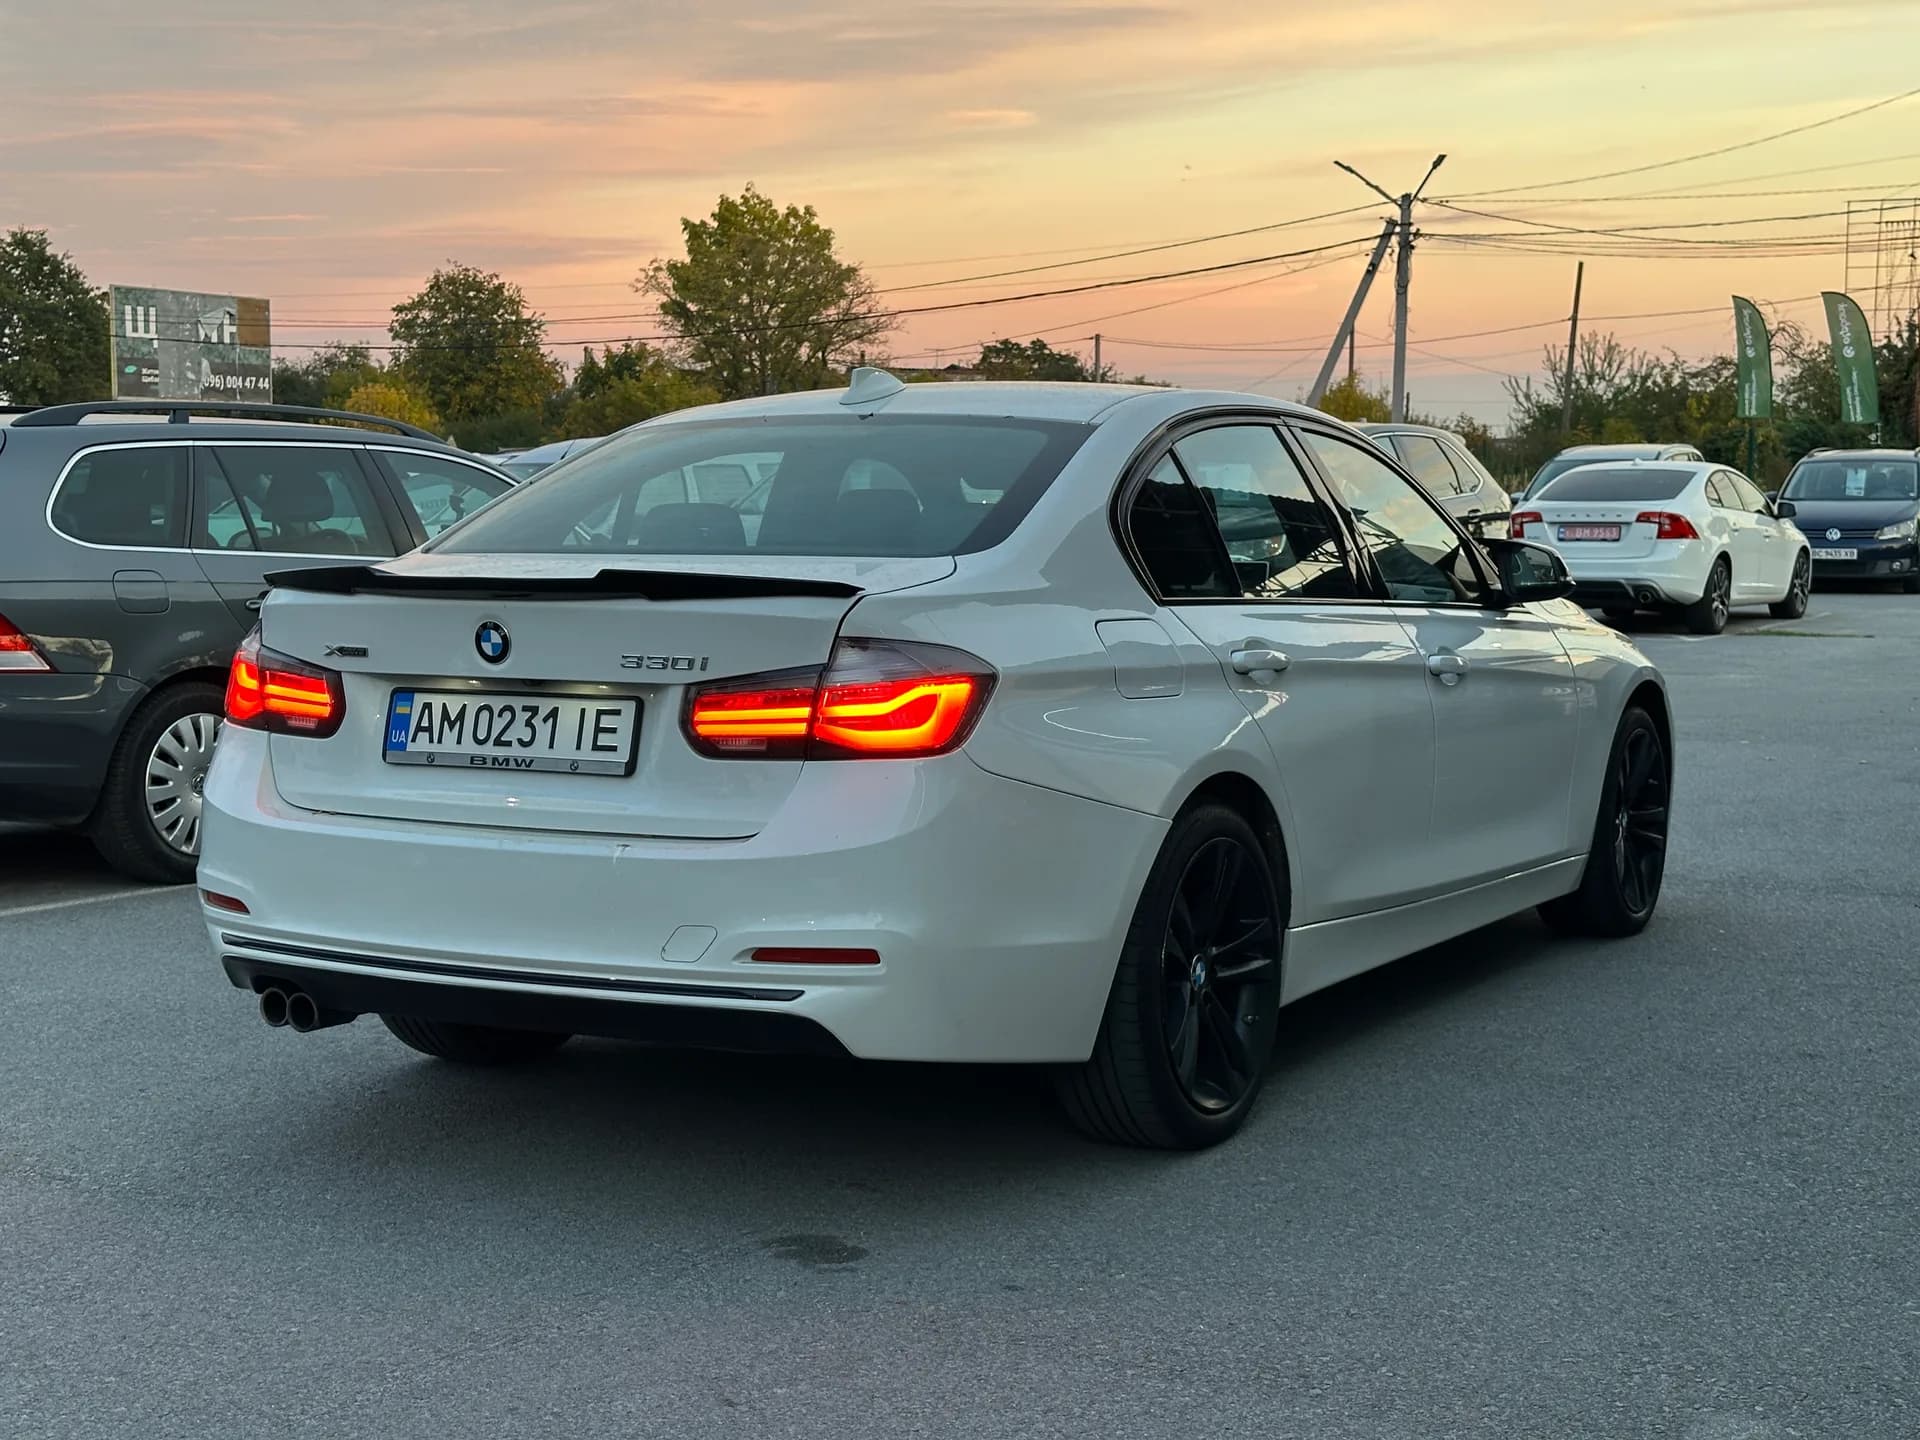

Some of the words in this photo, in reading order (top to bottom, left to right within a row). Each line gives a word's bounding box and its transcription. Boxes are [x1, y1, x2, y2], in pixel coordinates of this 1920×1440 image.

[226, 375, 242, 389] 004
[244, 376, 256, 389] 47
[257, 377, 270, 390] 44
[391, 730, 406, 743] UA
[575, 707, 622, 752] IE
[469, 755, 535, 769] BMW
